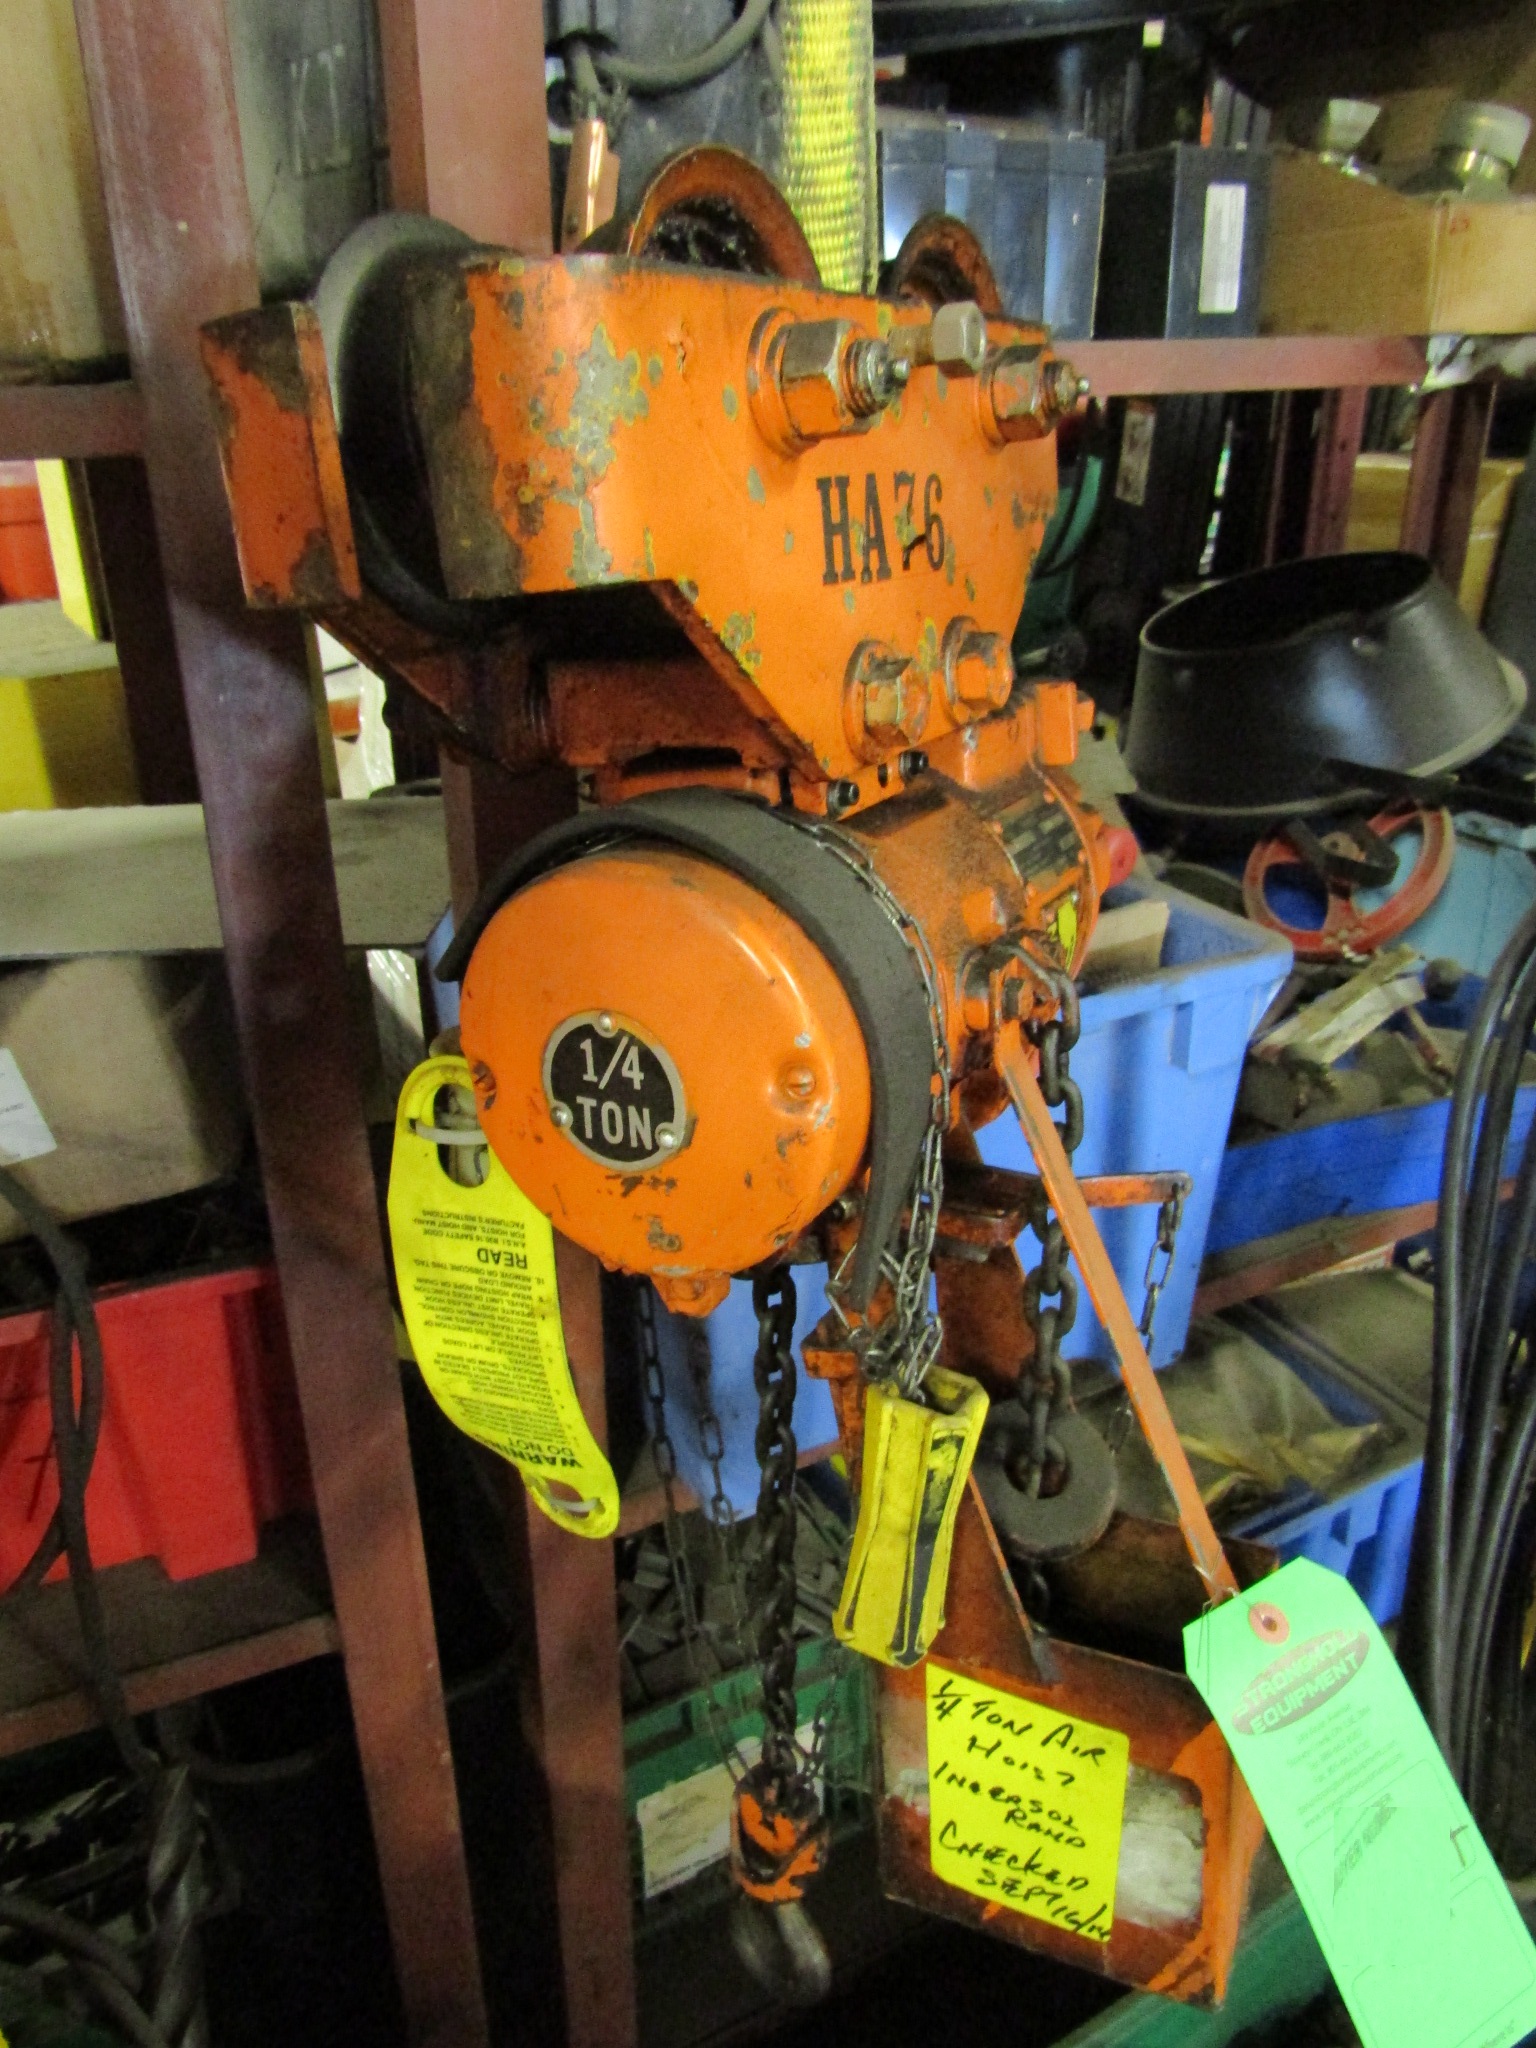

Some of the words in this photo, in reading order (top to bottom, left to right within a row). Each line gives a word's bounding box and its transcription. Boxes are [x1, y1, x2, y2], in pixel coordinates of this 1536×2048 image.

[579, 1036, 645, 1090] 1/4
[576, 1096, 652, 1150] TON
[423, 1228, 443, 1236] CODE
[446, 1231, 474, 1240] SAFETY
[477, 1248, 528, 1270] READ
[508, 1437, 542, 1453] NOT
[547, 1445, 574, 1458] DO
[1249, 1651, 1359, 1735] EQUIPMENT
[971, 1700, 1033, 1736] TON
